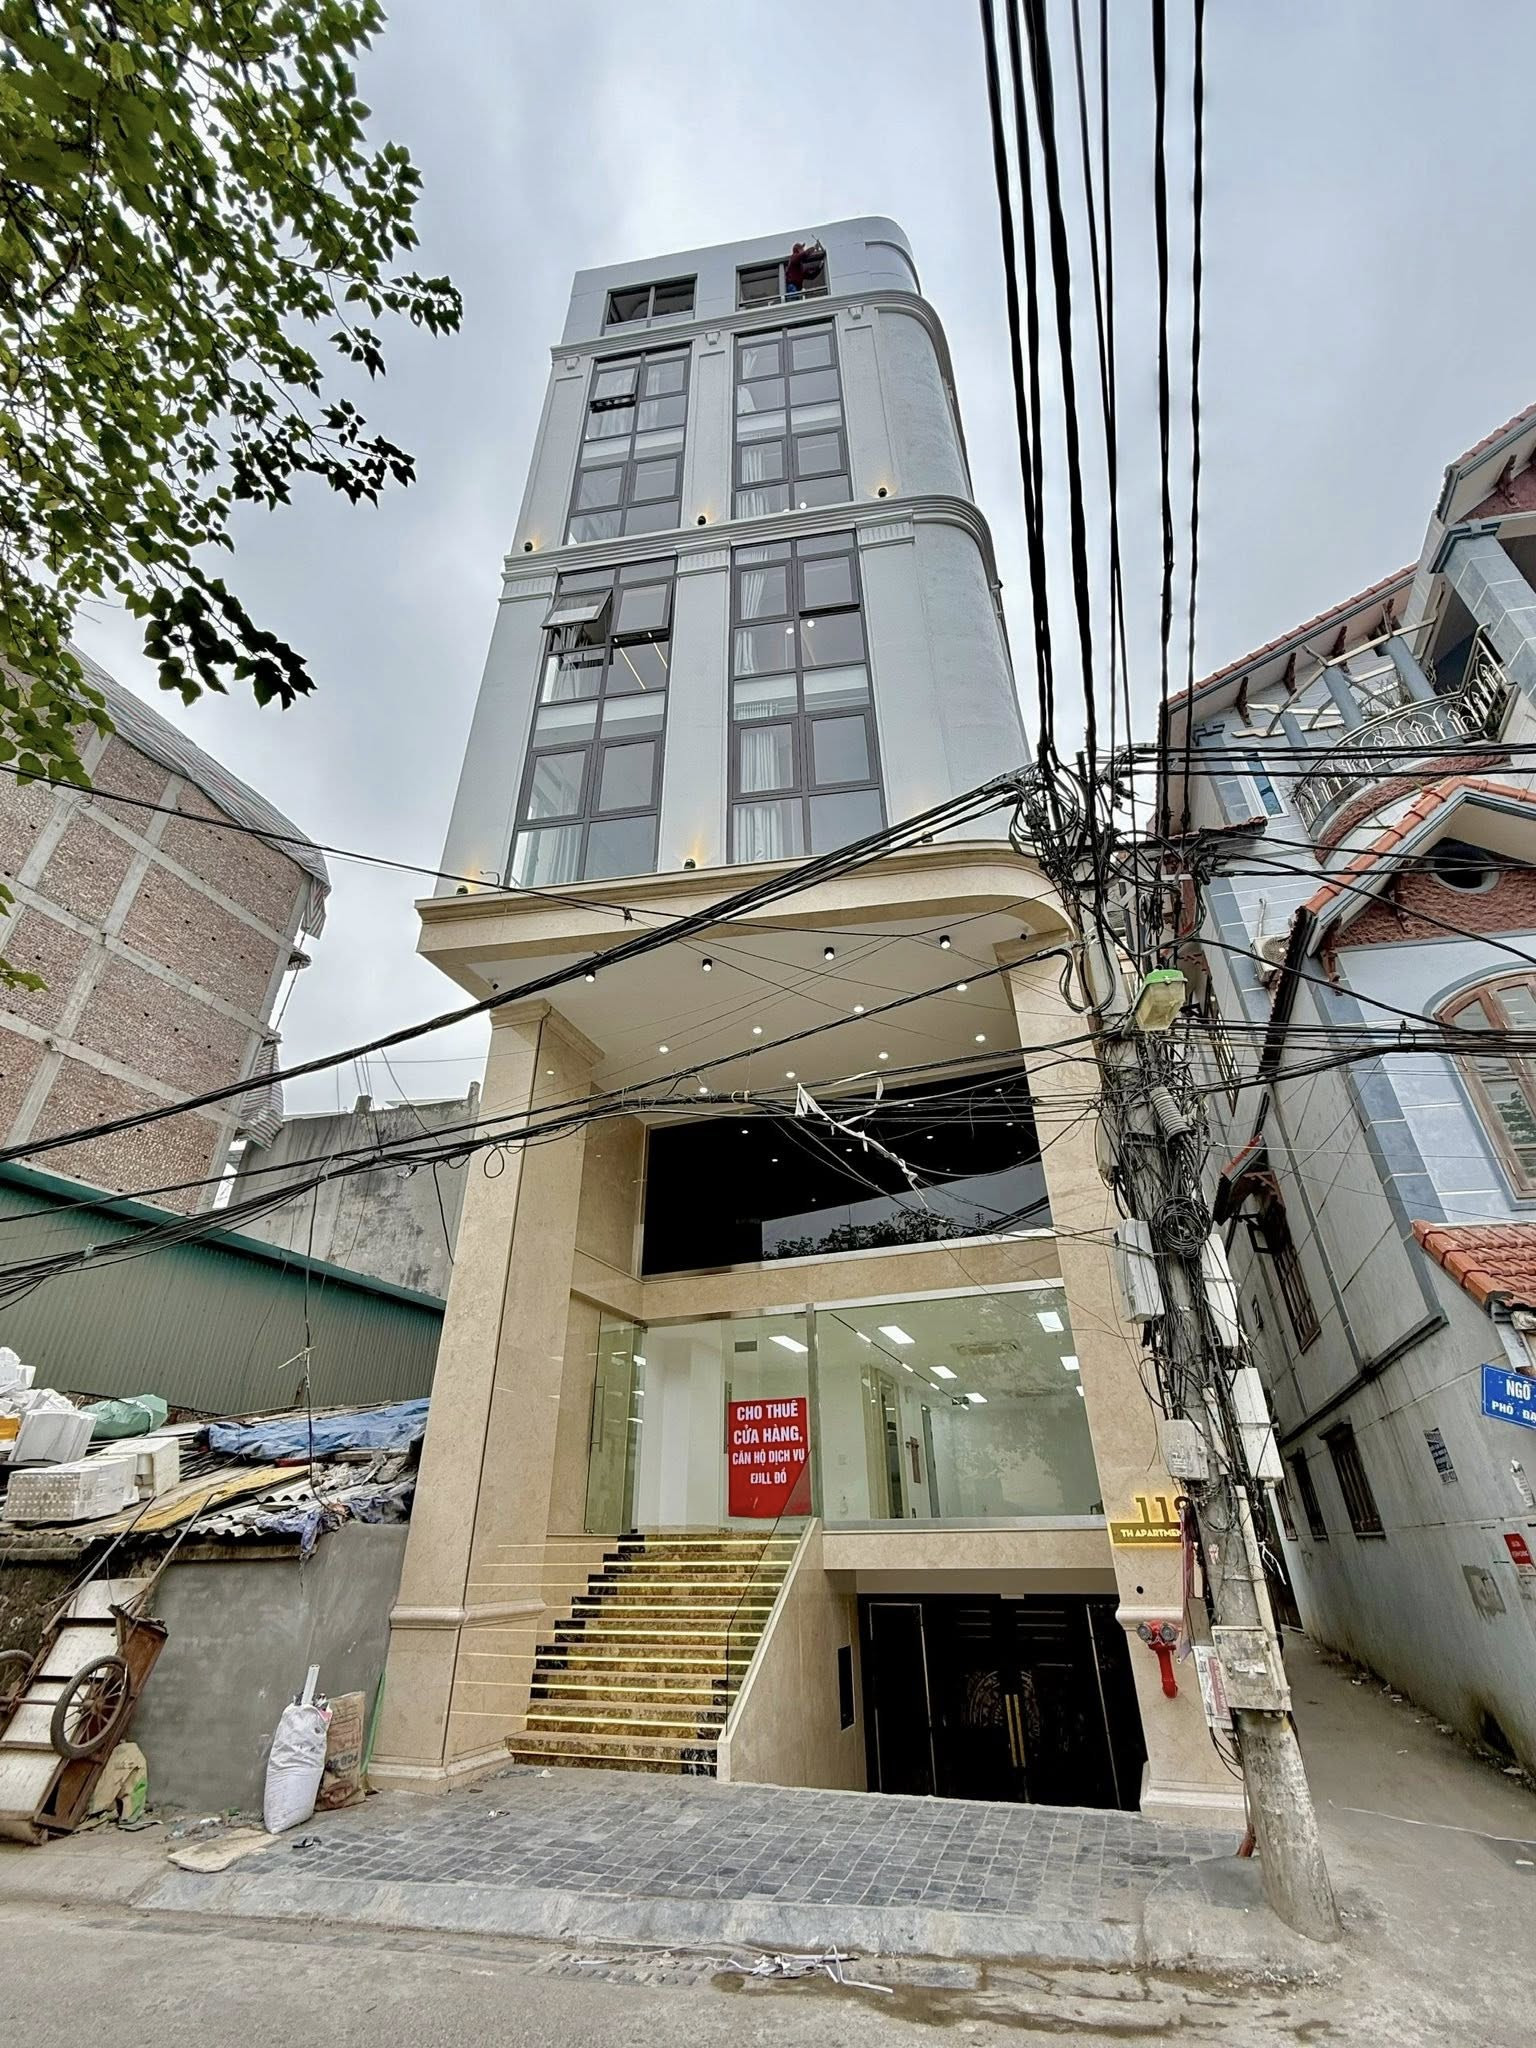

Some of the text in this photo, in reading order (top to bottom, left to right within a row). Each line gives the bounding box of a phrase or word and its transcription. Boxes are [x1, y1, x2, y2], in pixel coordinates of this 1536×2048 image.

[737, 1400, 798, 1421] CHO THUÊ
[734, 1424, 803, 1444] CỬA HÀNG,
[732, 1448, 805, 1466] CĂN HỘ DỊCH VỤ
[1120, 1529, 1134, 1538] TH
